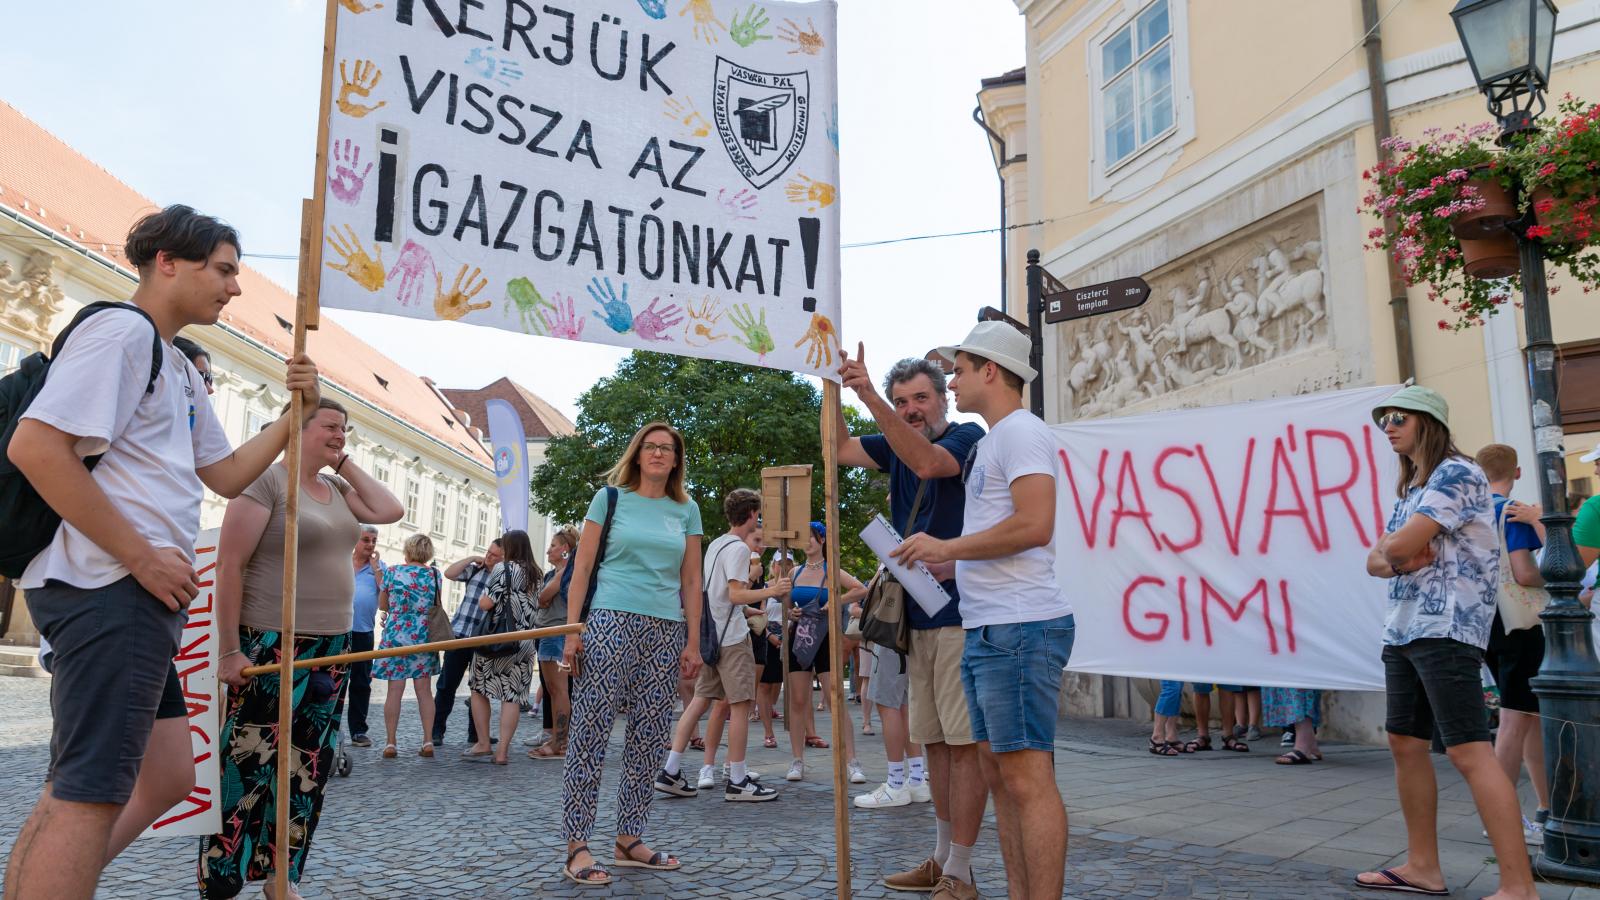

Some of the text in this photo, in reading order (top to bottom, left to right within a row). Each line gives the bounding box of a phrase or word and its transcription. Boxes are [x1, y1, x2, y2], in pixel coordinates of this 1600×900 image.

[773, 76, 794, 87] PÁL
[399, 55, 707, 196] VISSZA AZ
[1076, 287, 1109, 302] Ciszterci
[1077, 299, 1109, 312] templom
[1058, 424, 1385, 556] VASVÁRI
[1123, 575, 1296, 655] GIMI
